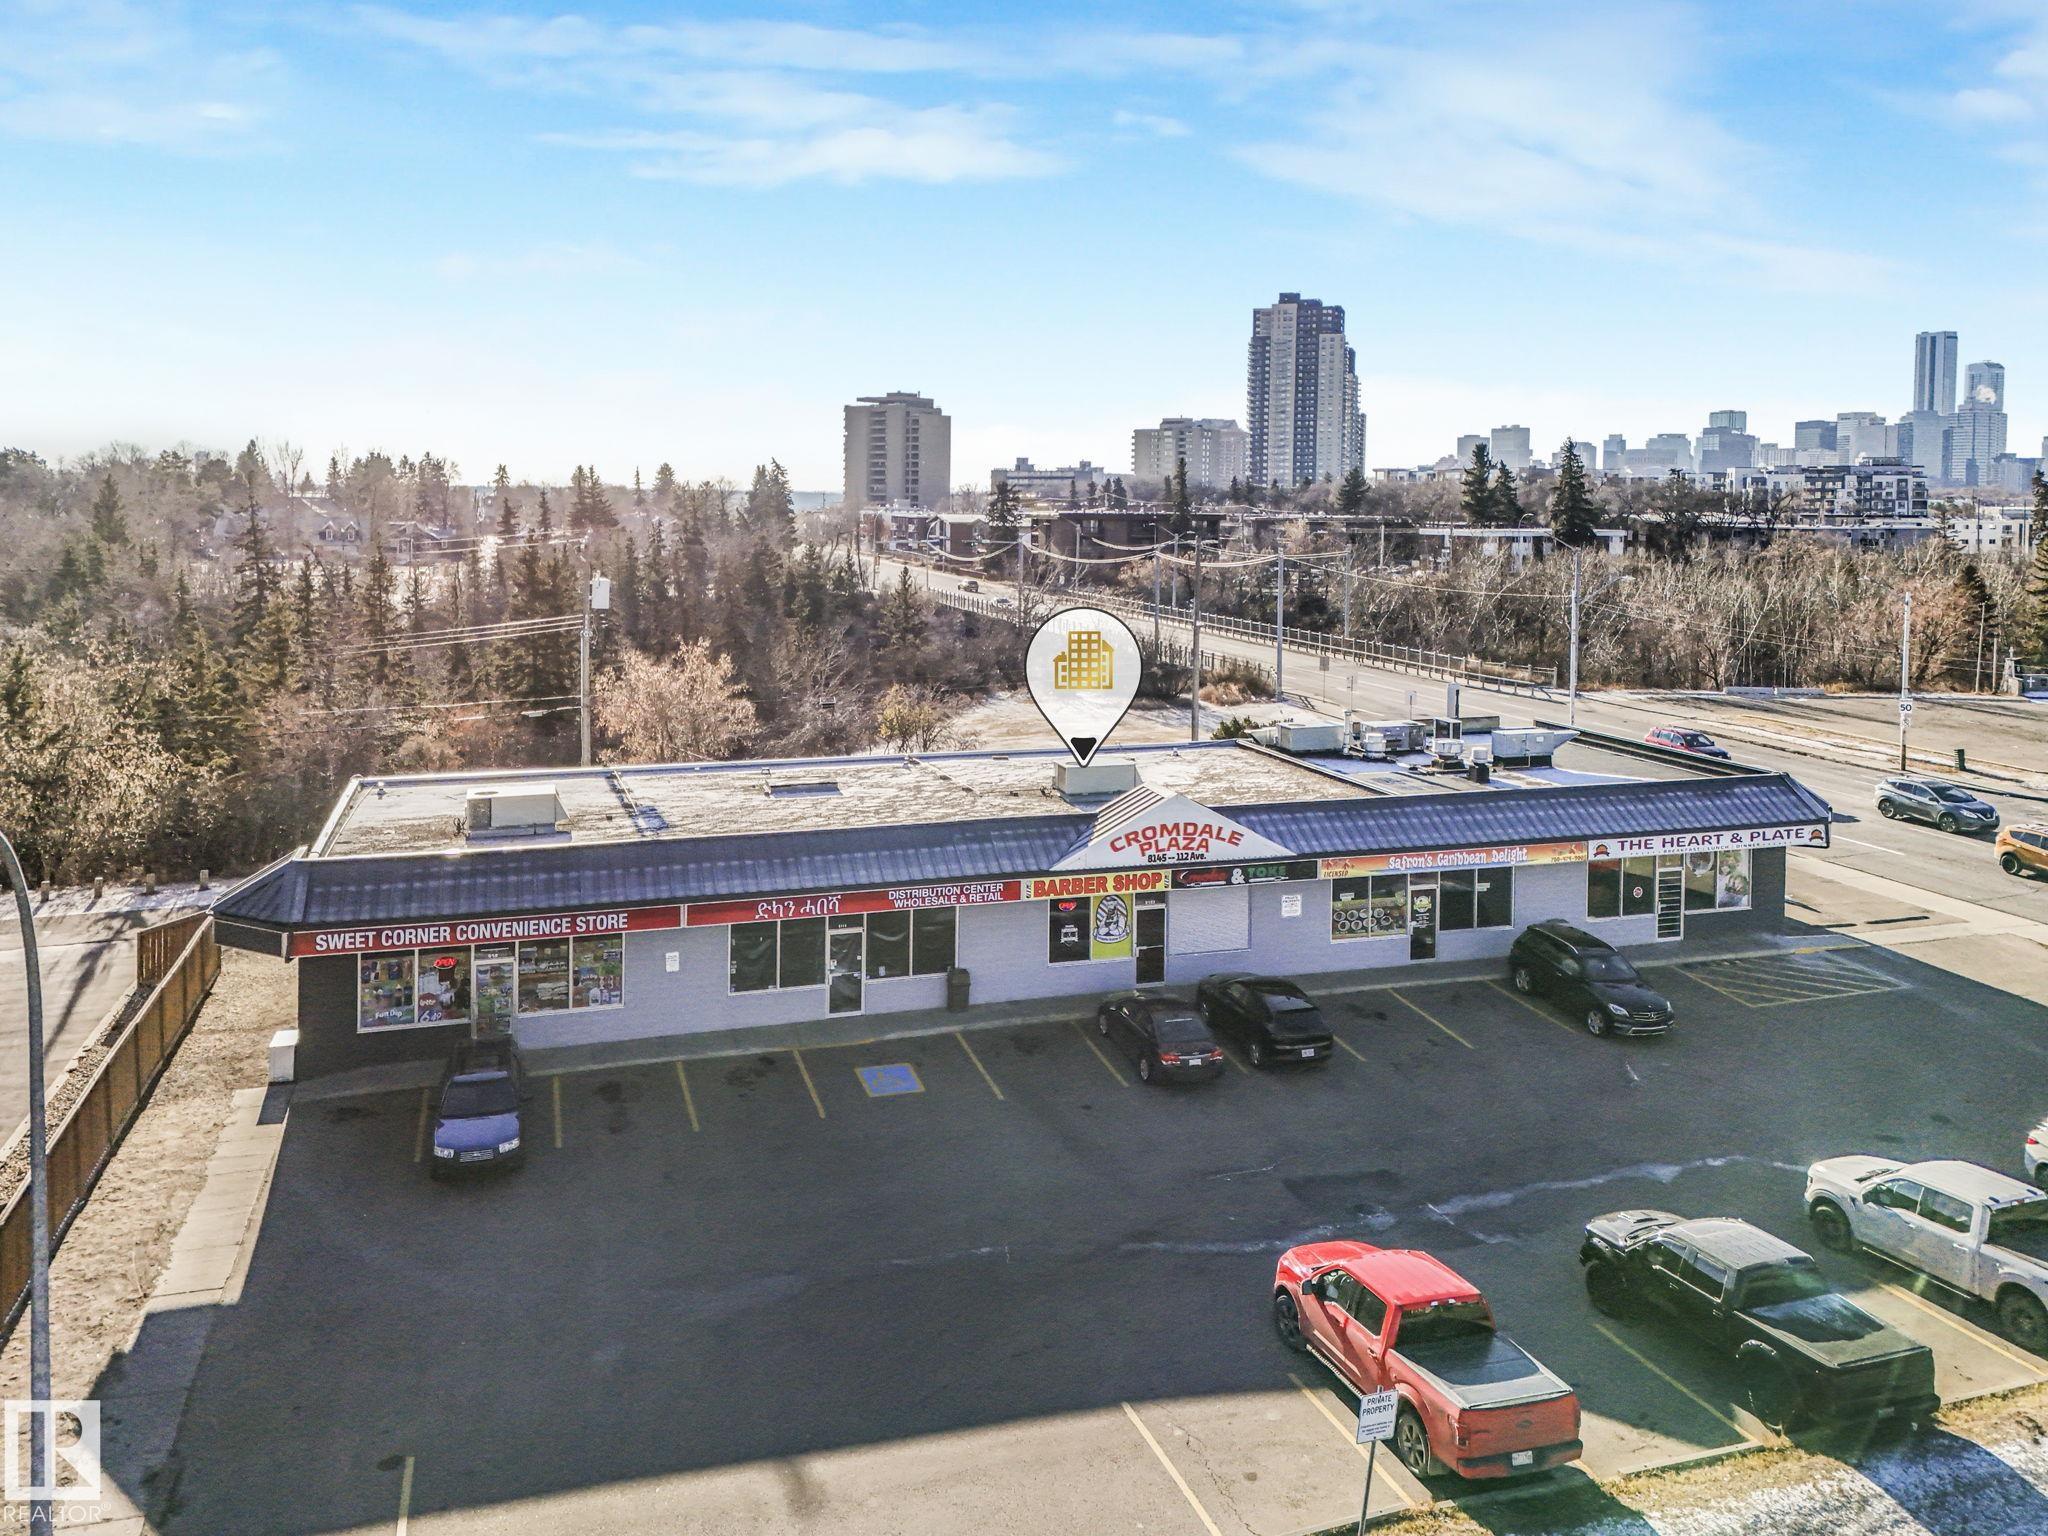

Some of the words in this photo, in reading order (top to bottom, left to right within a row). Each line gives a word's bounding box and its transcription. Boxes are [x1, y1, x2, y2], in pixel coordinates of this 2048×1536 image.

[1900, 704, 1912, 712] 50
[1109, 822, 1244, 853] CROMDALE
[1618, 838, 1655, 851] THE
[1662, 833, 1724, 849] HEART
[1730, 832, 1743, 844] &
[1750, 828, 1805, 842] PLATE
[1139, 837, 1210, 857] PLAZA
[1663, 846, 1700, 854] BREAKFAST
[1147, 853, 1167, 863] 8145
[1176, 852, 1189, 861] 112
[1190, 852, 1207, 860] Ave.
[1389, 853, 1433, 871] Safron's
[1437, 851, 1487, 867] Caribbean
[1491, 847, 1528, 865] Delight
[1231, 867, 1246, 885] &
[1247, 865, 1287, 877] TOKE
[1323, 870, 1349, 878] LICENSED
[888, 886, 961, 900] DISTRIBUTION
[963, 883, 1004, 894] CENTER
[1033, 875, 1109, 898] BARBER
[1113, 872, 1163, 892] SHOP
[894, 895, 958, 908] WHOLESALE
[959, 894, 967, 903] &
[969, 892, 1004, 902] RETAIL
[315, 931, 377, 951] SWEET
[381, 926, 451, 947] CORNER
[456, 918, 571, 941] CONVENIENCE
[576, 913, 628, 932] STORE
[1367, 1394, 1392, 1405] PRIVATE
[1362, 1403, 1395, 1416] PROPERTY
